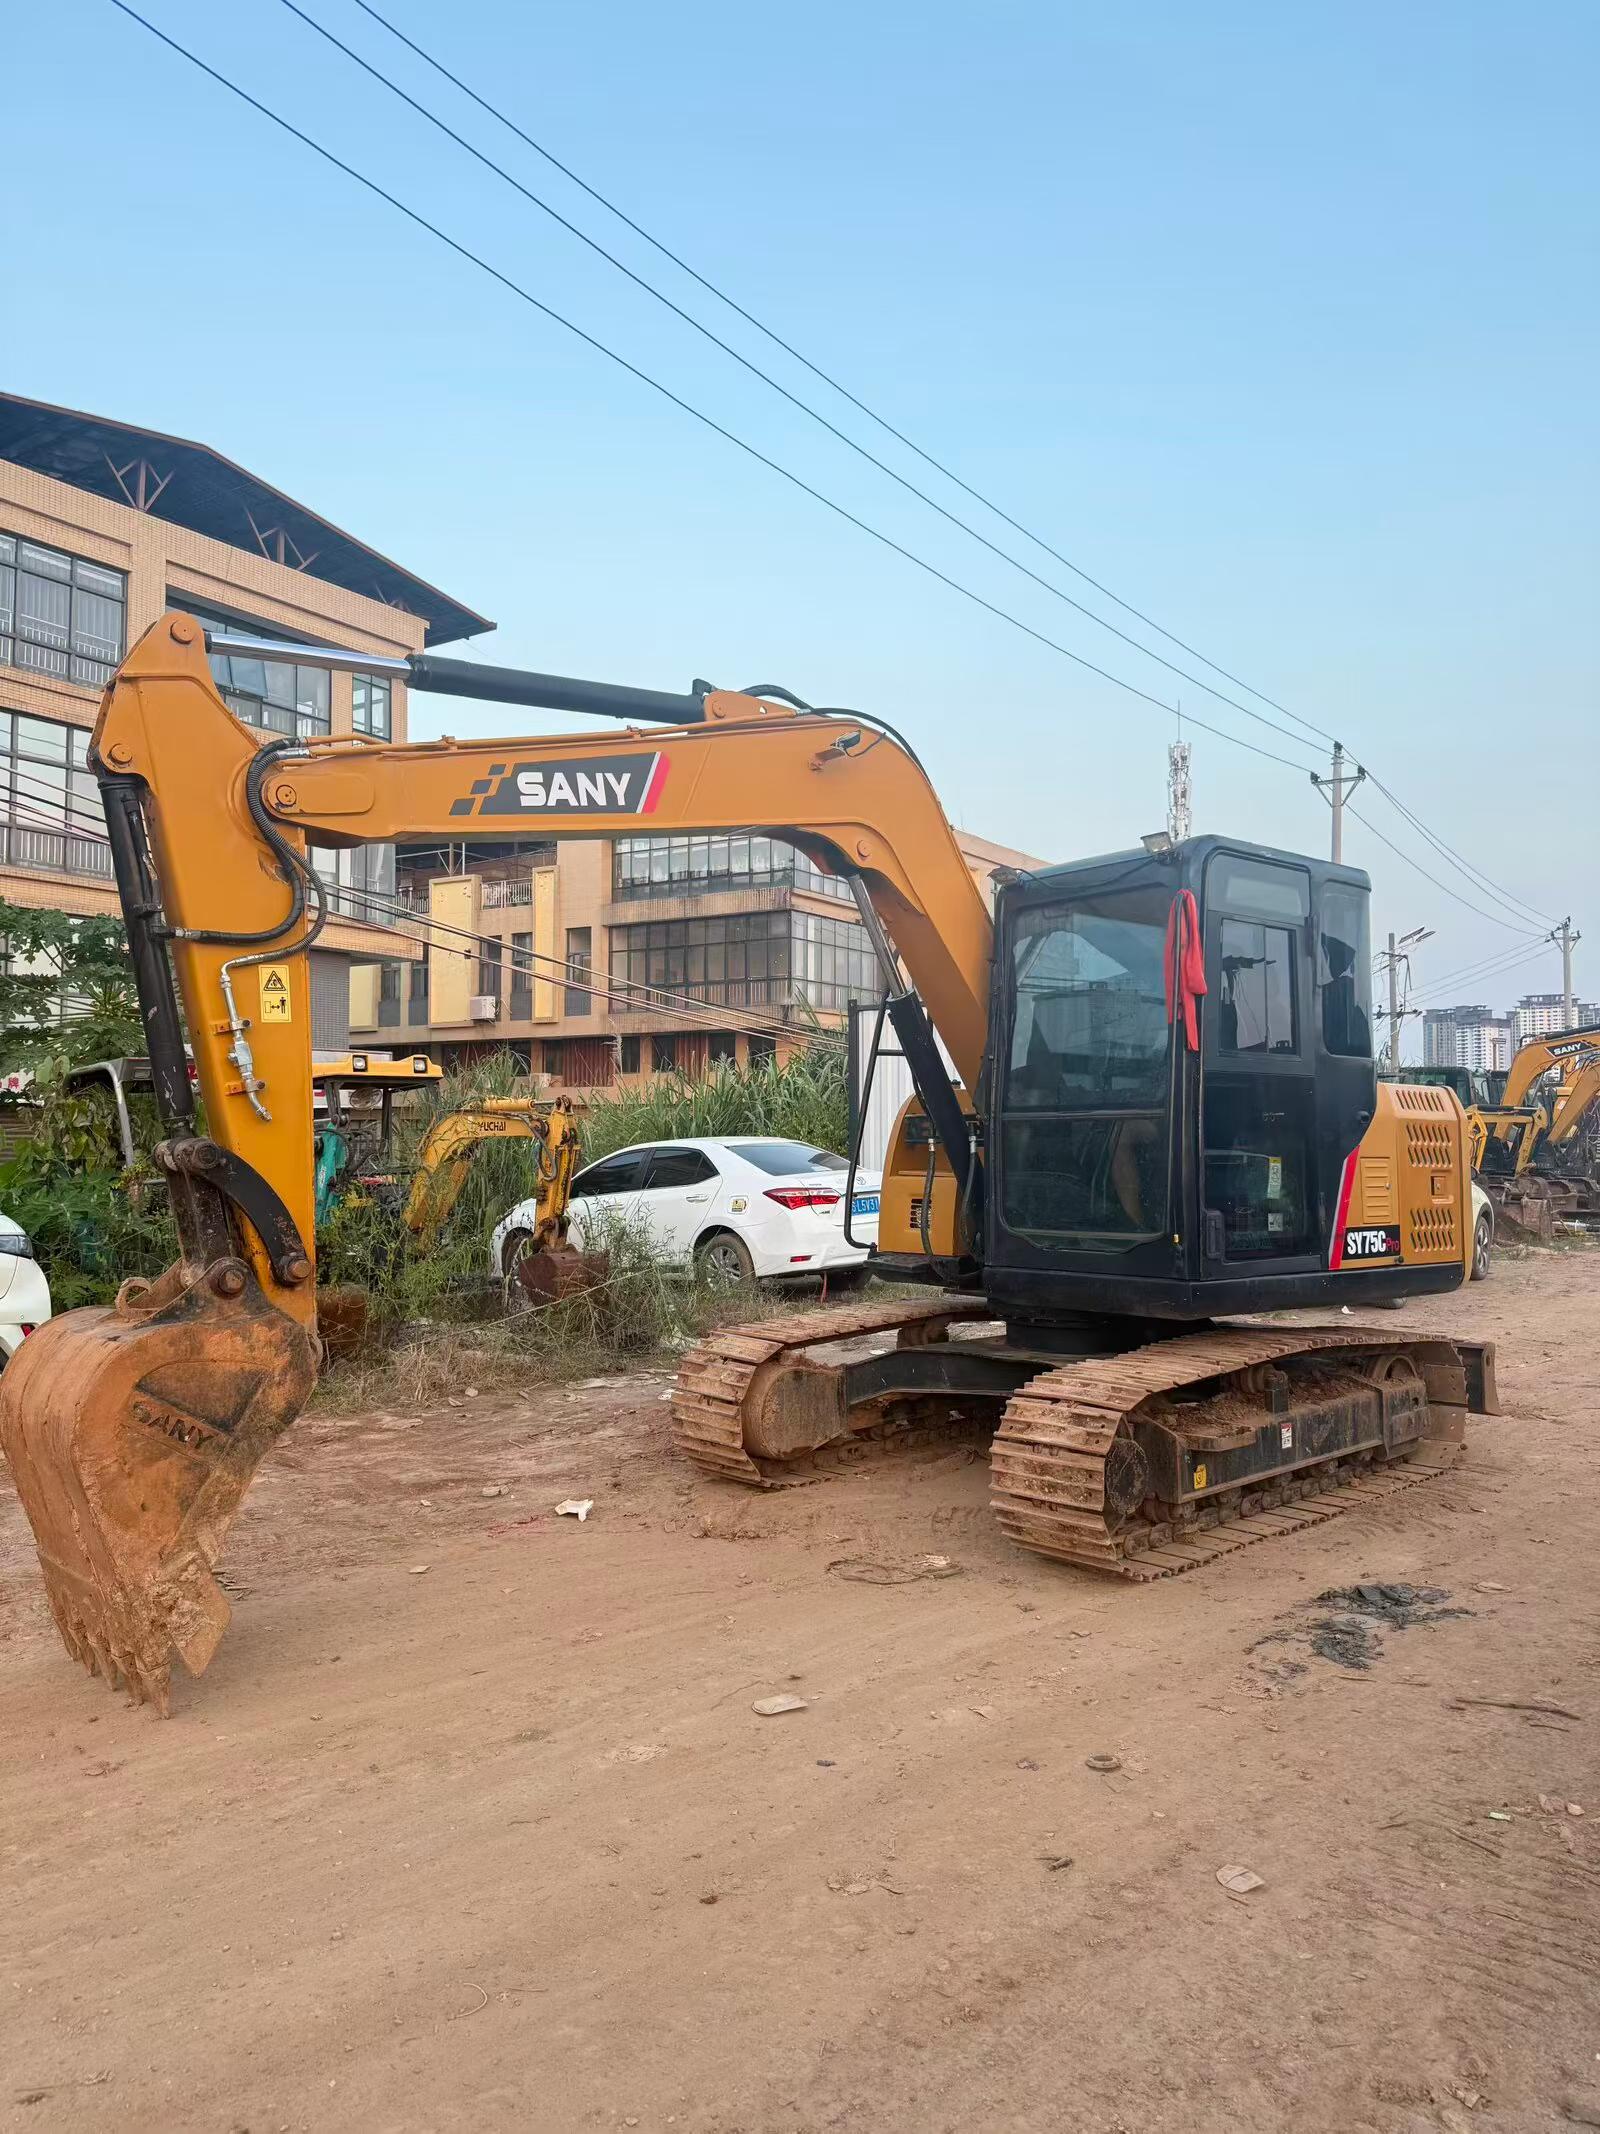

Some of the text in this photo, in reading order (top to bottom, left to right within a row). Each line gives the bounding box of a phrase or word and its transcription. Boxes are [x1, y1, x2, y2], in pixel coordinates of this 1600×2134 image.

[516, 771, 632, 807] SANY
[1553, 1043, 1581, 1055] SANY
[1346, 1230, 1386, 1255] SY75C
